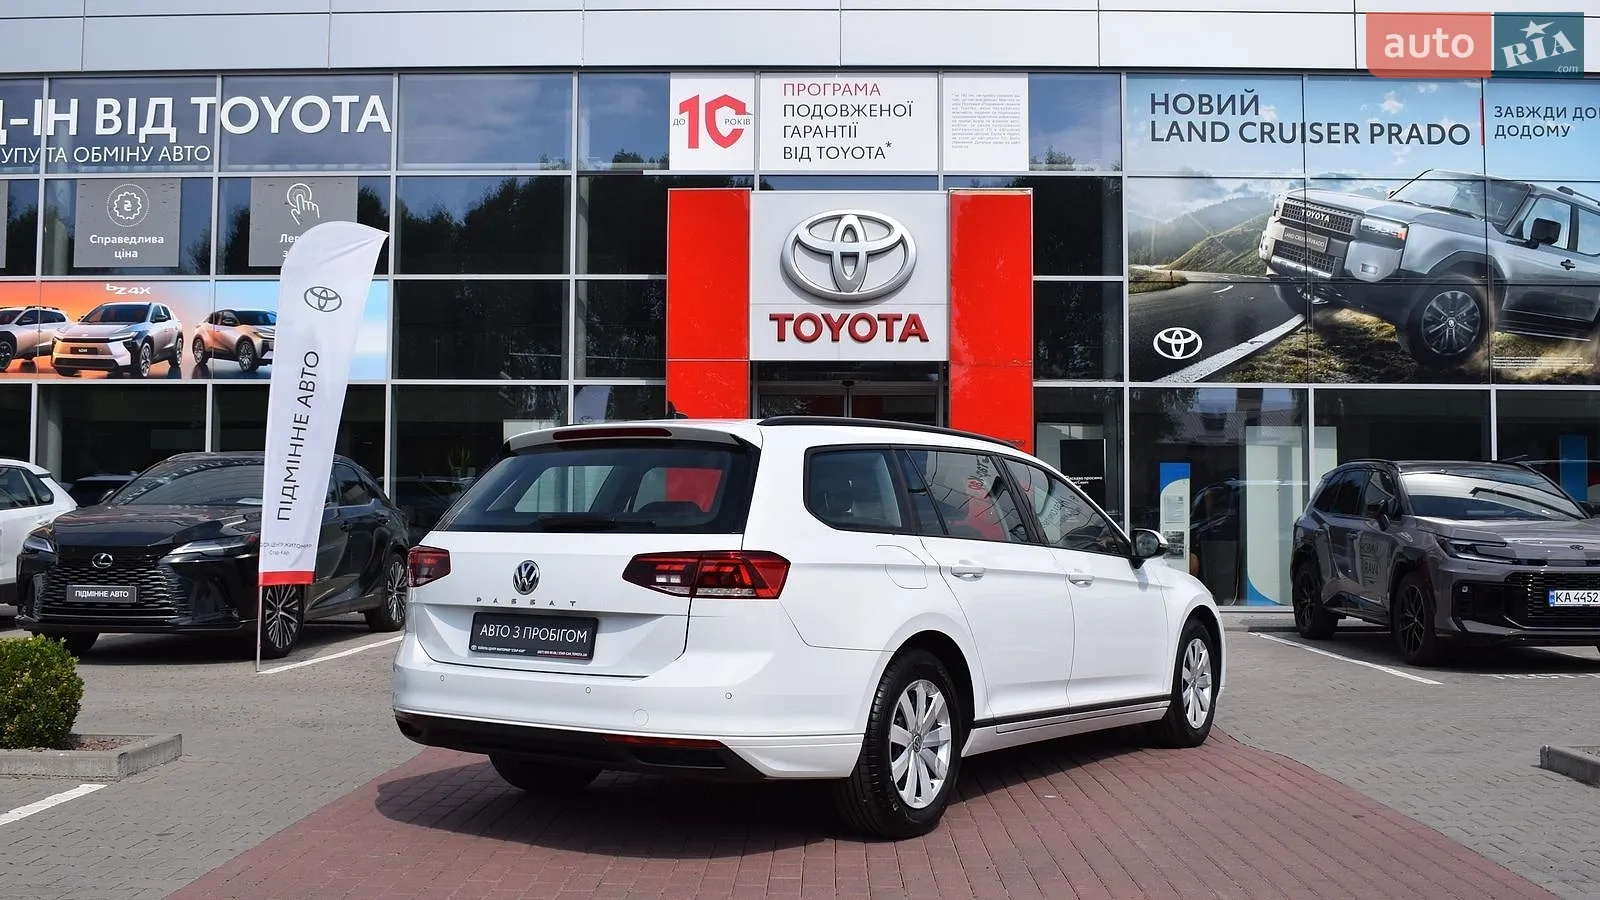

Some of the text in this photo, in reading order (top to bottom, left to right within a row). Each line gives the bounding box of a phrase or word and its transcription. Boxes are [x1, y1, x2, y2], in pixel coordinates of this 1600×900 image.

[783, 83, 881, 97] ПРОГРАМА
[783, 100, 914, 120] ПОДОВЖЕНОЇ
[1150, 88, 1260, 116] НОВИЙ
[0, 95, 392, 146] -ІН ВІД TOYOTA
[1494, 105, 1600, 121] ЗАВЖДИ ДО
[672, 118, 686, 127] ДО
[724, 118, 751, 126] РОКІВ
[783, 121, 859, 139] ГАРАНТІЇ
[1150, 120, 1471, 146] LAND CRUISER PRADO
[1494, 124, 1571, 140] ДОДОМУ
[46, 146, 68, 163] ТА
[73, 146, 154, 163] ОБМІНУ
[158, 145, 211, 162] АВТО
[783, 146, 812, 163] ВІД
[1301, 209, 1330, 223] TOYOTA
[89, 234, 165, 246] Справедлива
[280, 233, 301, 243] Лег
[114, 248, 138, 260] ціна
[769, 312, 929, 343] TOYOTA
[277, 351, 319, 521] ПІДМІННЕ АВТО
[75, 590, 129, 598] ПІДМІННЕ АВТО
[476, 596, 577, 608] PASSAT
[1555, 592, 1599, 603] KA 4452
[480, 624, 511, 639] АВТО
[522, 626, 588, 643] ПРОБІГОМ
